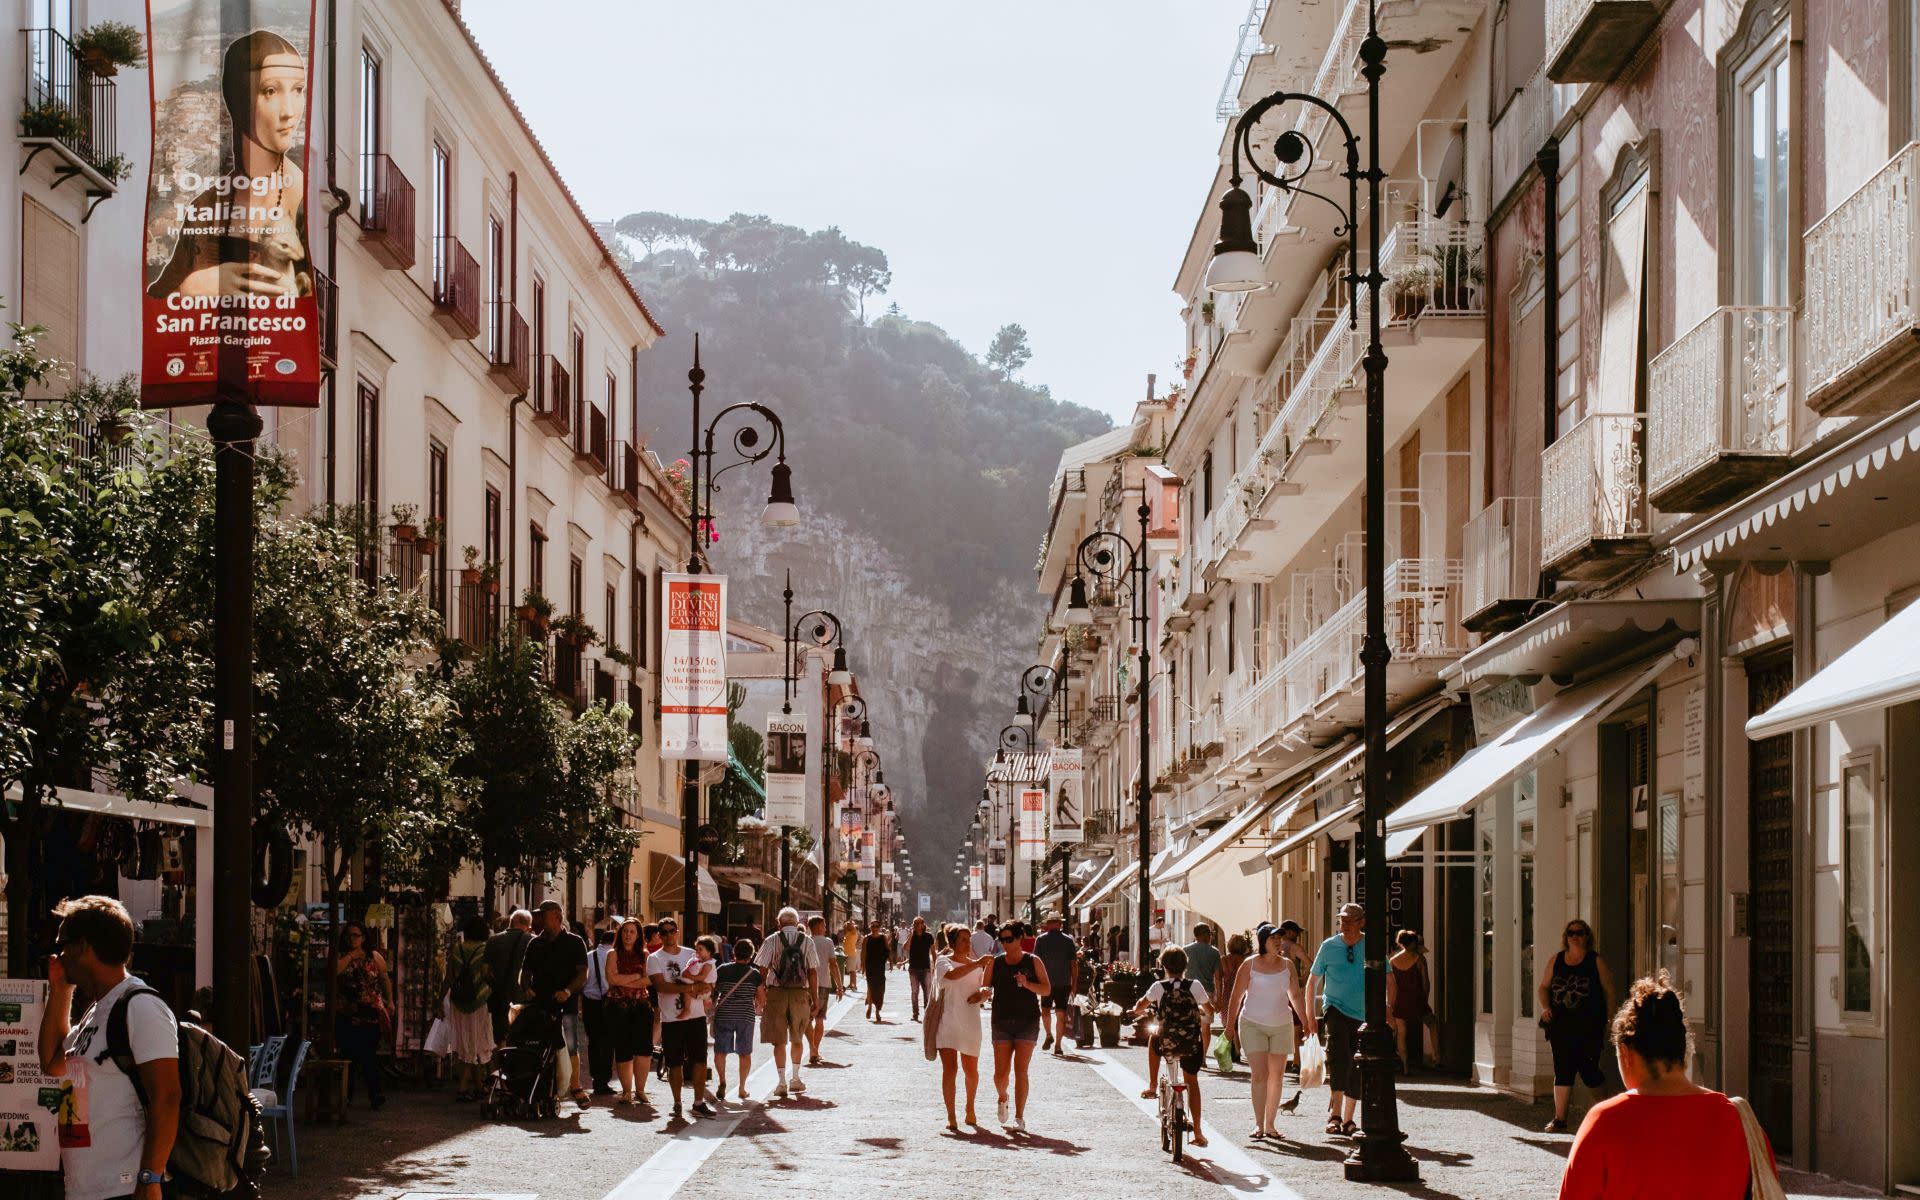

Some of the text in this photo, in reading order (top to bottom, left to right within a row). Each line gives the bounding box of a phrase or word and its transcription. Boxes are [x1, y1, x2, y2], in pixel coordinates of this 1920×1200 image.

[175, 202, 285, 222] Italiano
[168, 226, 179, 235] In
[183, 226, 225, 235] mostra
[228, 225, 235, 233] a
[167, 292, 296, 311] Convento di
[157, 313, 306, 333] San Francesco
[190, 335, 271, 348] Piazza Gargiulo
[671, 591, 718, 601] INCONTRI
[690, 611, 718, 619] SAPORI
[671, 617, 719, 627] CAMPANI
[673, 656, 717, 666] 14/15/16
[666, 676, 684, 685] Villa
[770, 723, 805, 732] BACON
[1053, 763, 1081, 771] BACON
[0, 1028, 29, 1036] SHARING
